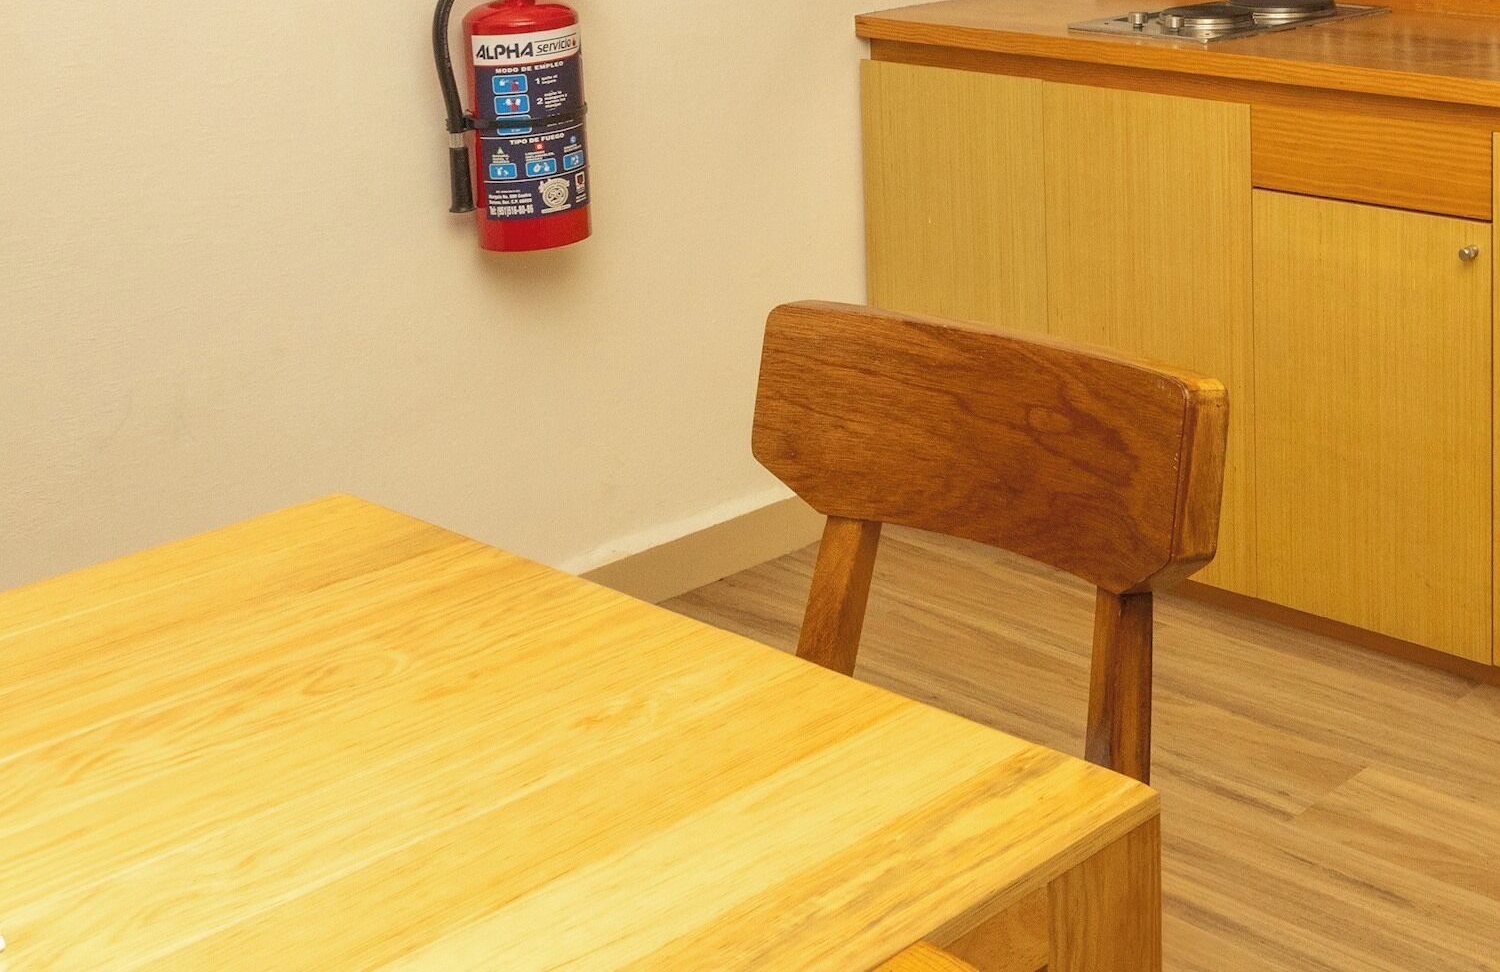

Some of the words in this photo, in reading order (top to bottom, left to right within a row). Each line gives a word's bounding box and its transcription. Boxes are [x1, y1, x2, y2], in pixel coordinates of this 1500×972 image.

[476, 42, 534, 60] ALPHA
[536, 37, 571, 54] servicio
[534, 61, 564, 71] EMPLEO
[541, 133, 565, 142] FUEGO
